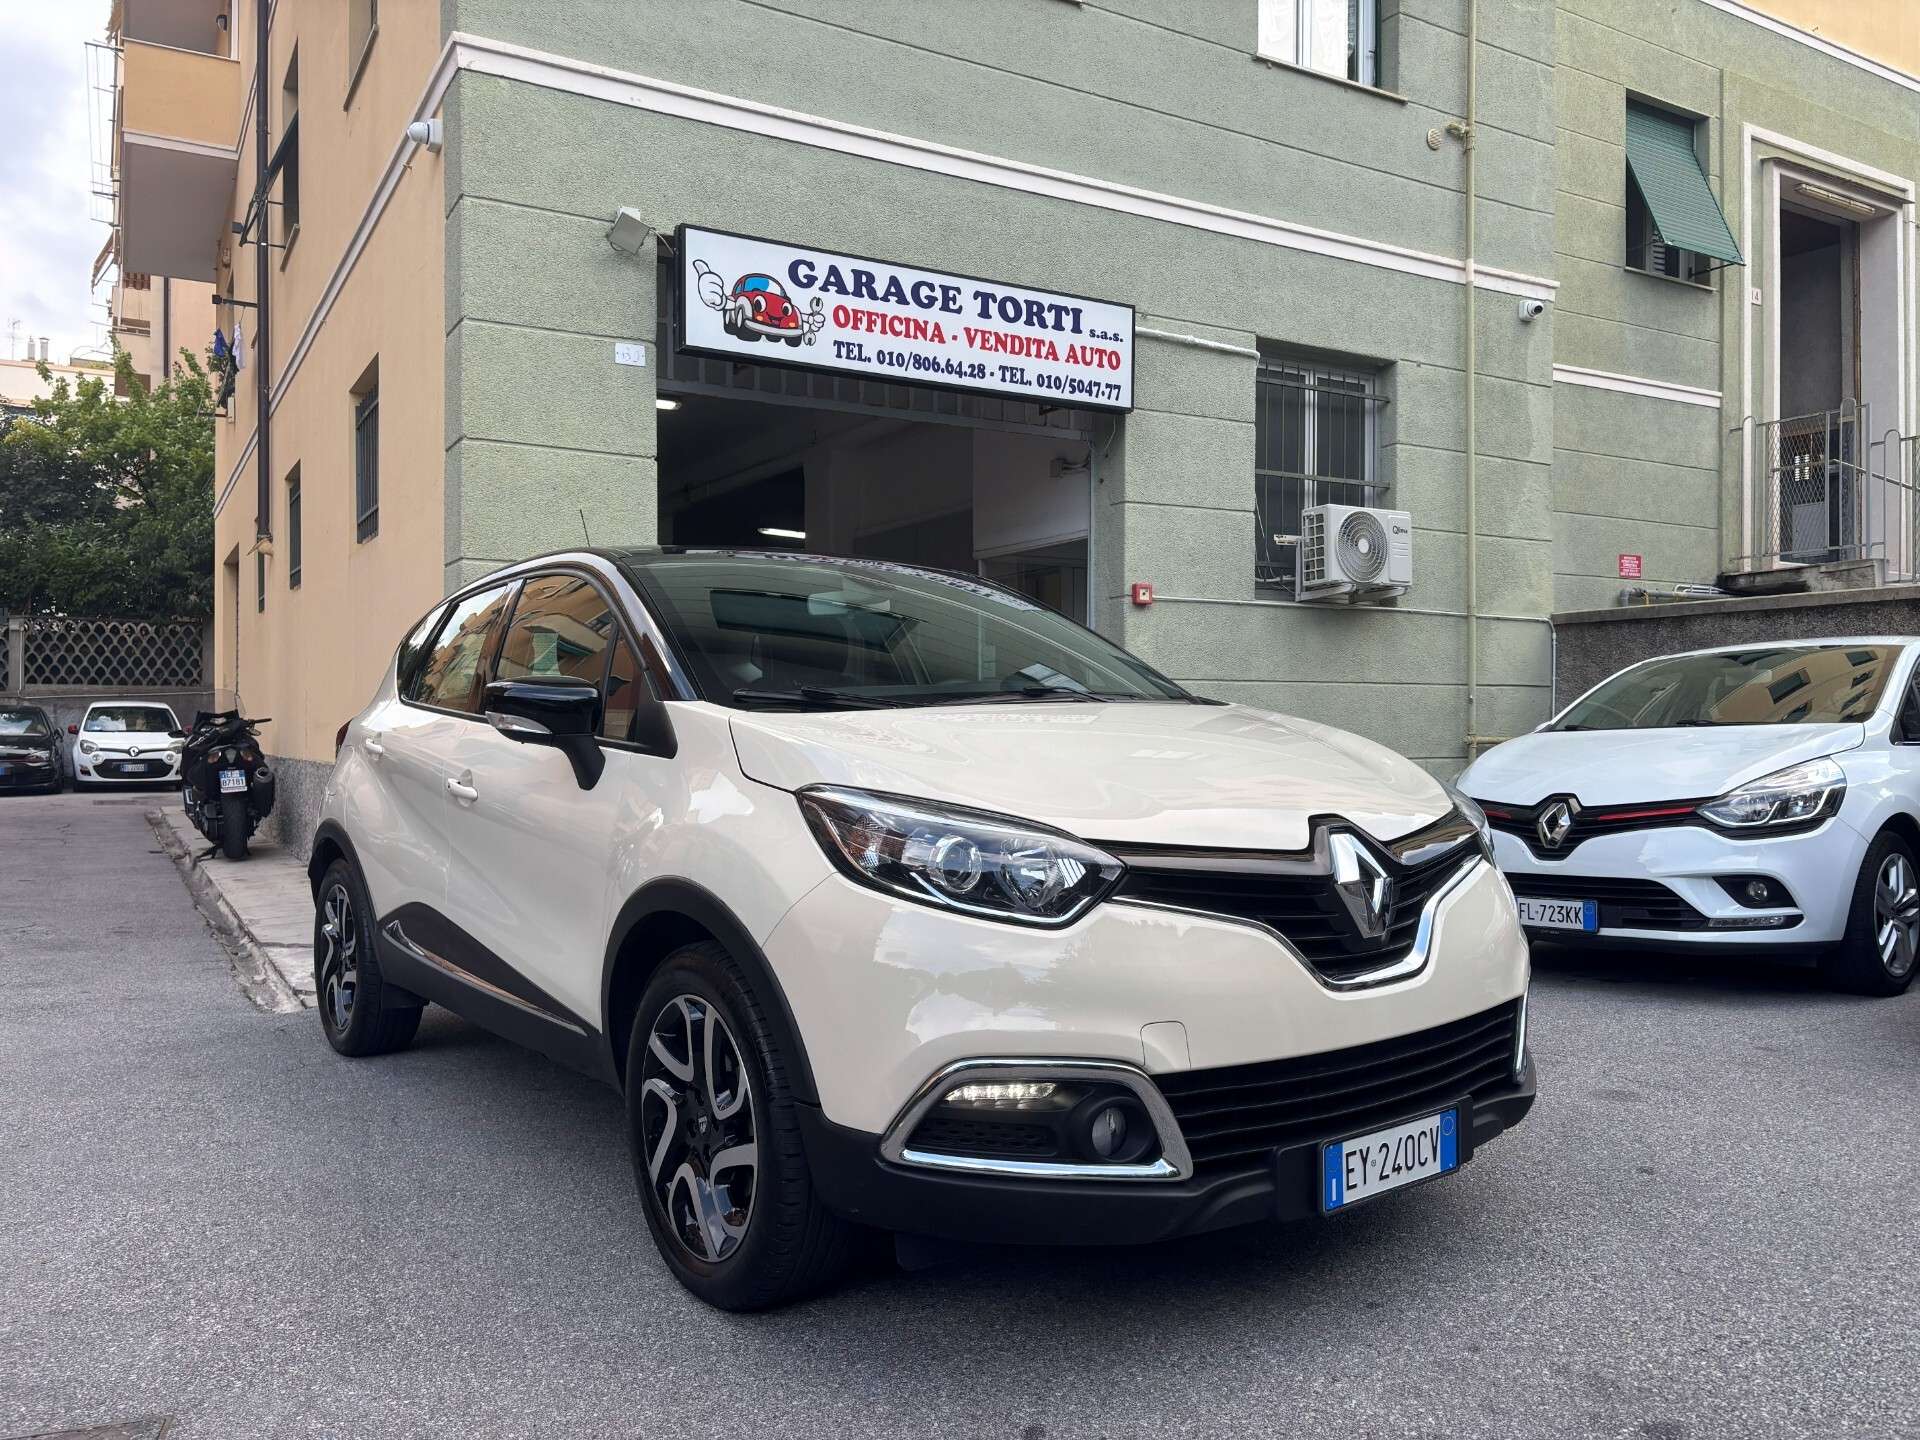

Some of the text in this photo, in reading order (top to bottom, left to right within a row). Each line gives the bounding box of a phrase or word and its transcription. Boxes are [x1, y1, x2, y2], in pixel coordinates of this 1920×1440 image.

[788, 259, 1123, 342] GARAGE TORTI s.a.s.
[833, 304, 946, 344] OFFICINA
[963, 327, 1060, 362] VENDITA
[1065, 344, 1121, 370] AUTO
[833, 340, 871, 363] TEL.
[876, 349, 986, 379] 010/806.64.28
[998, 365, 1032, 387] TEL.
[1036, 374, 1122, 401] 010/5047.77
[1519, 902, 1582, 925] FL 723KK
[1345, 1146, 1370, 1191] EY
[1378, 1125, 1440, 1181] 240CV
